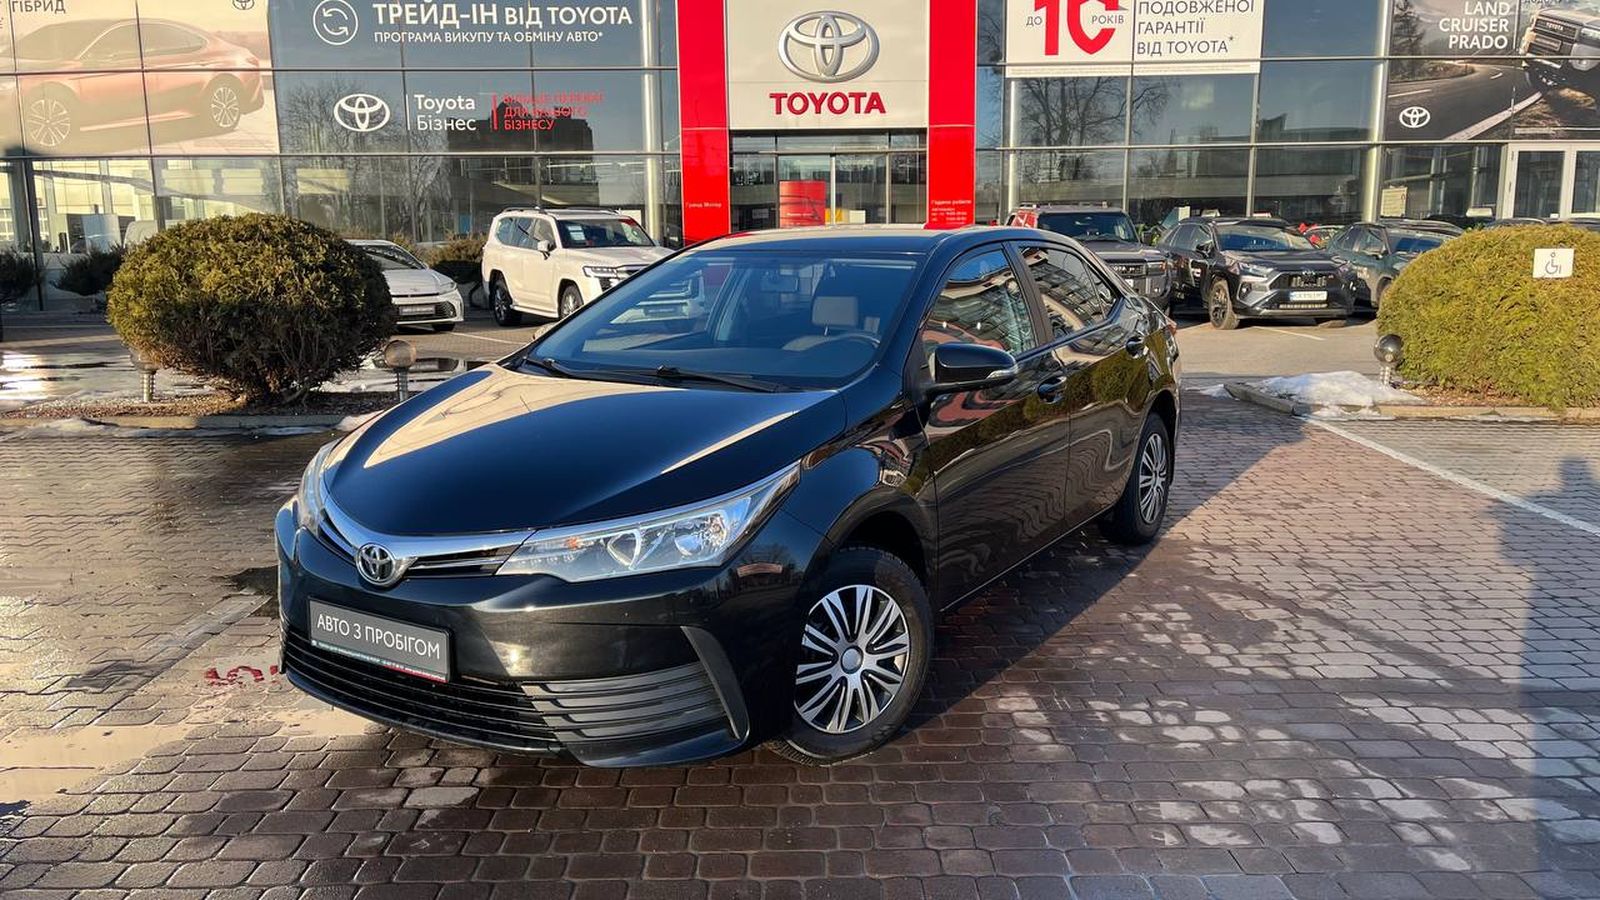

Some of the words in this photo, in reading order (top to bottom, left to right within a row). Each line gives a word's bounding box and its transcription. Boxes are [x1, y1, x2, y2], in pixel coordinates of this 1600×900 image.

[372, 0, 498, 29] ТРЕЙД-ІН
[505, 7, 543, 29] ВІД
[546, 6, 633, 25] TOYOTA
[1464, 1, 1510, 15] LAND
[1025, 15, 1043, 27] ДО
[1091, 14, 1125, 25] РОКІВ
[1137, 17, 1206, 35] ГАРАНТІЇ
[1439, 17, 1510, 32] CRUISER
[374, 31, 442, 43] ПРОГРАМА
[444, 31, 495, 43] ВИКУПУ
[496, 31, 512, 42] ТА
[514, 31, 564, 42] ОБМІНУ
[1448, 35, 1508, 49] PRADO
[1136, 41, 1162, 57] ВІД
[413, 94, 476, 115] Toyota
[769, 91, 886, 116] TOYOTA
[416, 114, 478, 131] Бізнес
[503, 119, 555, 131] БІЗНЕСУ
[317, 613, 350, 636] АВТО
[353, 622, 362, 640] З
[365, 626, 440, 659] ПРОБІГОМ
